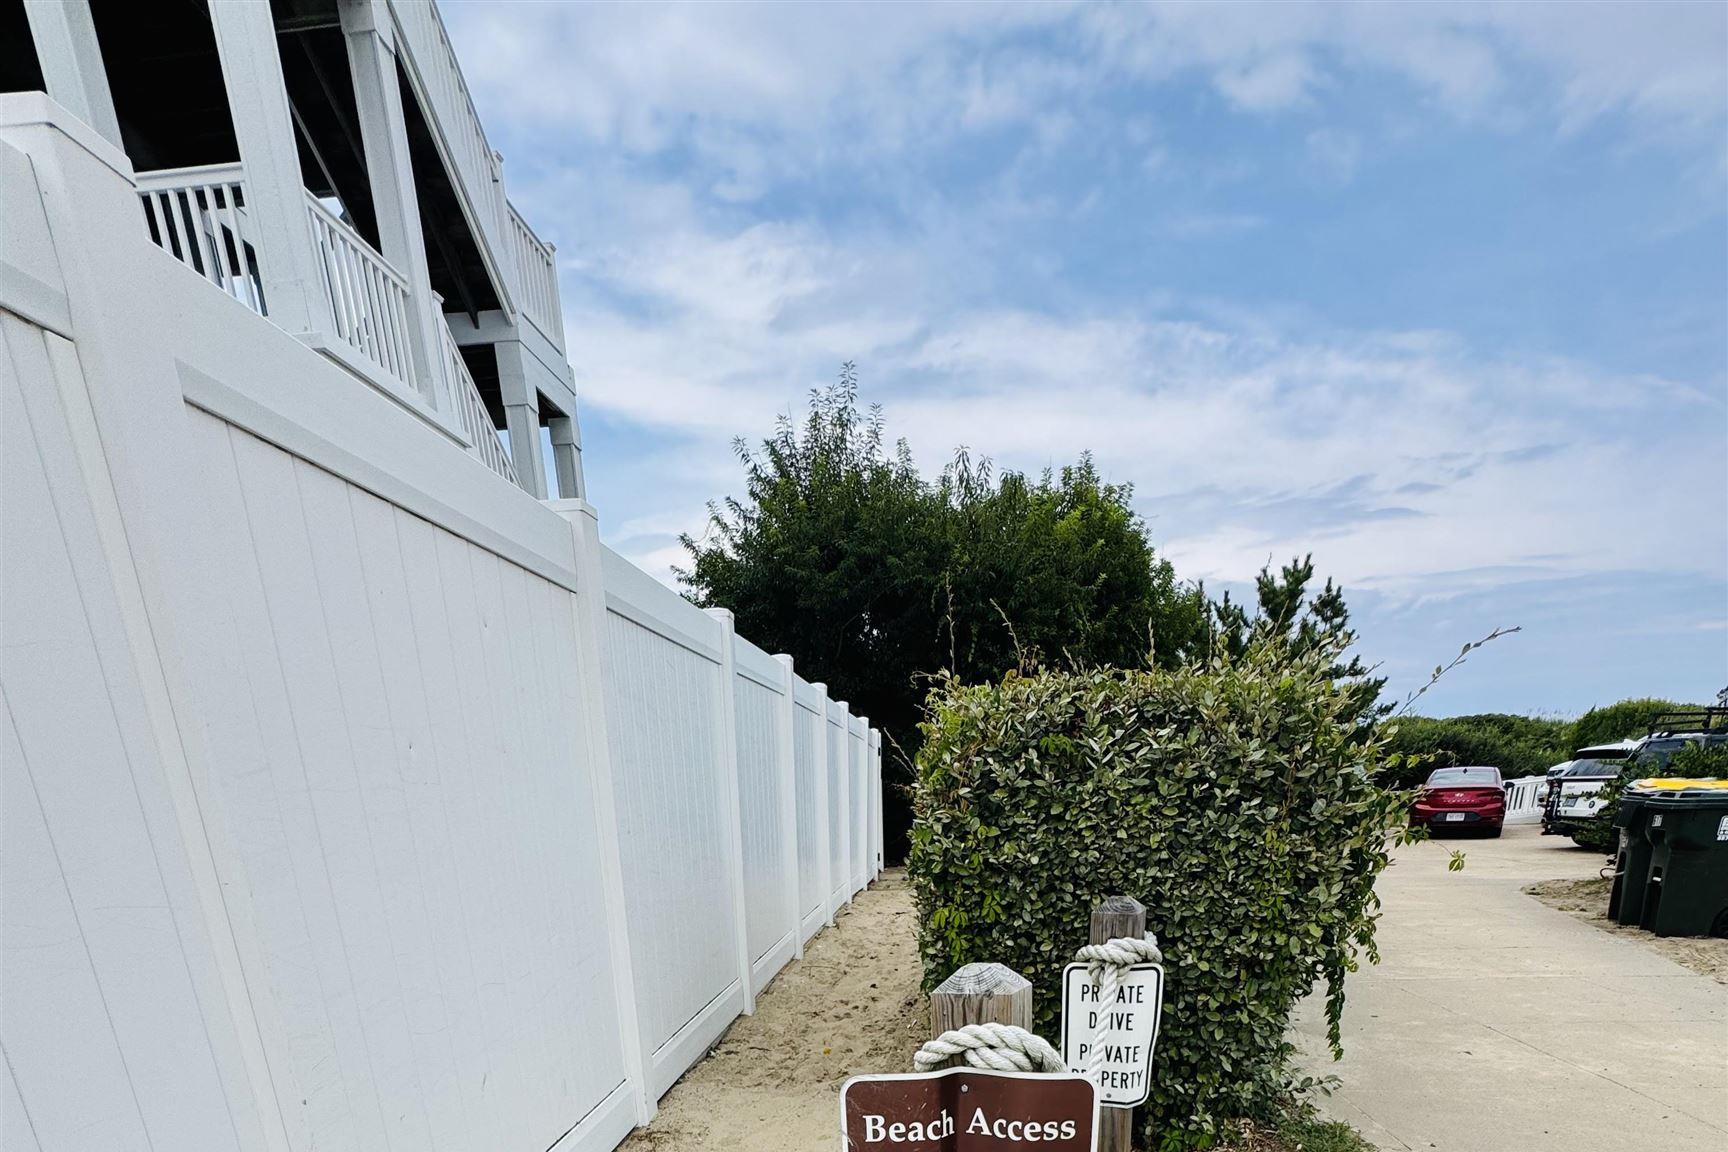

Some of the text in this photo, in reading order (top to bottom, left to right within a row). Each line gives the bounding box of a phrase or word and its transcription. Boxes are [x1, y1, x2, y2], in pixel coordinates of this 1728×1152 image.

[1081, 983, 1144, 1004] PRATE
[1089, 1011, 1135, 1031] DIVE
[1072, 1043, 1141, 1064] PVATE
[1071, 1068, 1145, 1089] PERTY
[862, 1107, 1077, 1143] Beach Access
